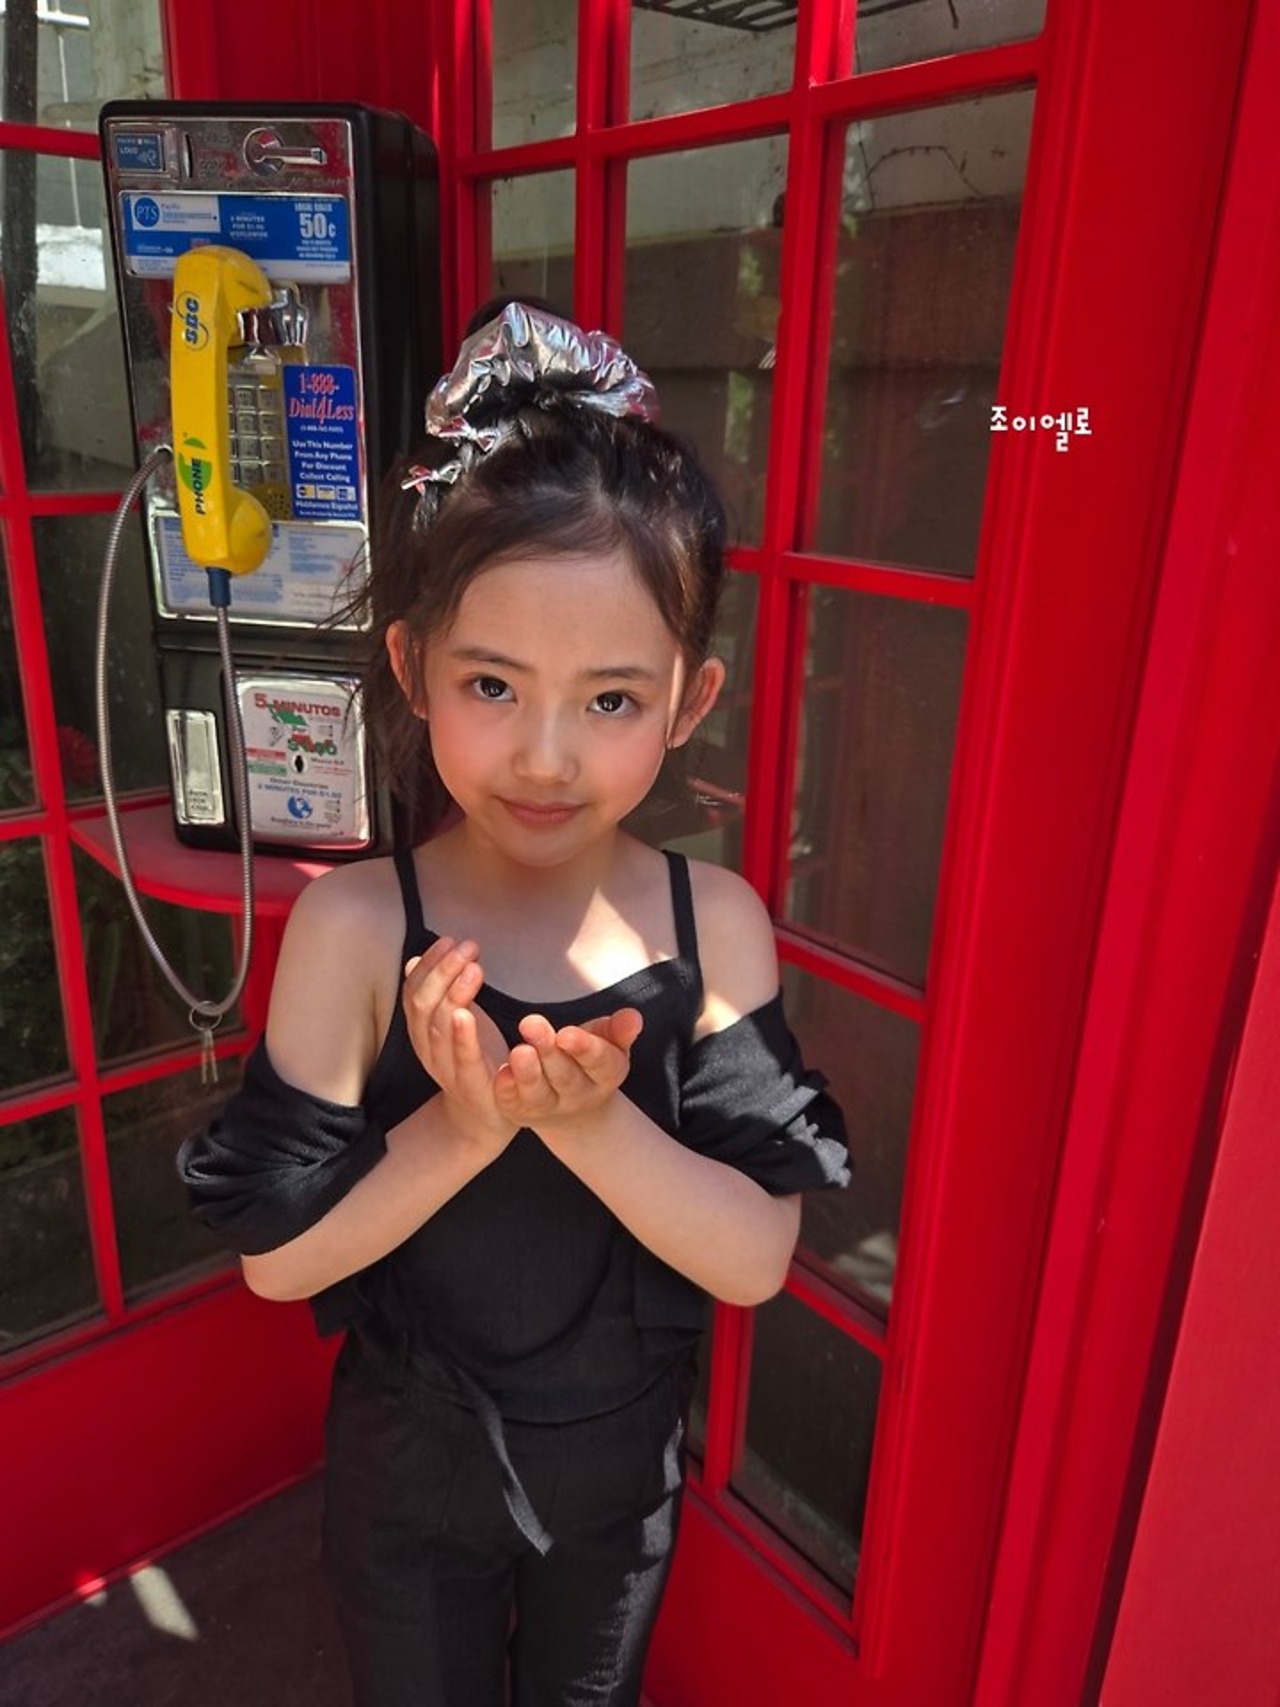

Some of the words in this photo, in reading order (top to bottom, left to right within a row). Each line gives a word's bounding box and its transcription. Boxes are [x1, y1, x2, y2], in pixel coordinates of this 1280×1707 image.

[136, 205, 158, 220] PTS
[185, 297, 199, 345] SBC
[292, 440, 306, 448] Use
[307, 441, 322, 449] This
[323, 441, 353, 450] Number
[294, 450, 314, 459] From
[315, 451, 329, 461] Any
[330, 452, 353, 461] Phone
[301, 461, 314, 469] For
[316, 462, 347, 471] Discount
[299, 472, 324, 480] Collect
[326, 473, 351, 484] Calling
[191, 457, 206, 516] PHONE
[254, 693, 268, 710] 5
[273, 699, 342, 718] MINUTOS
